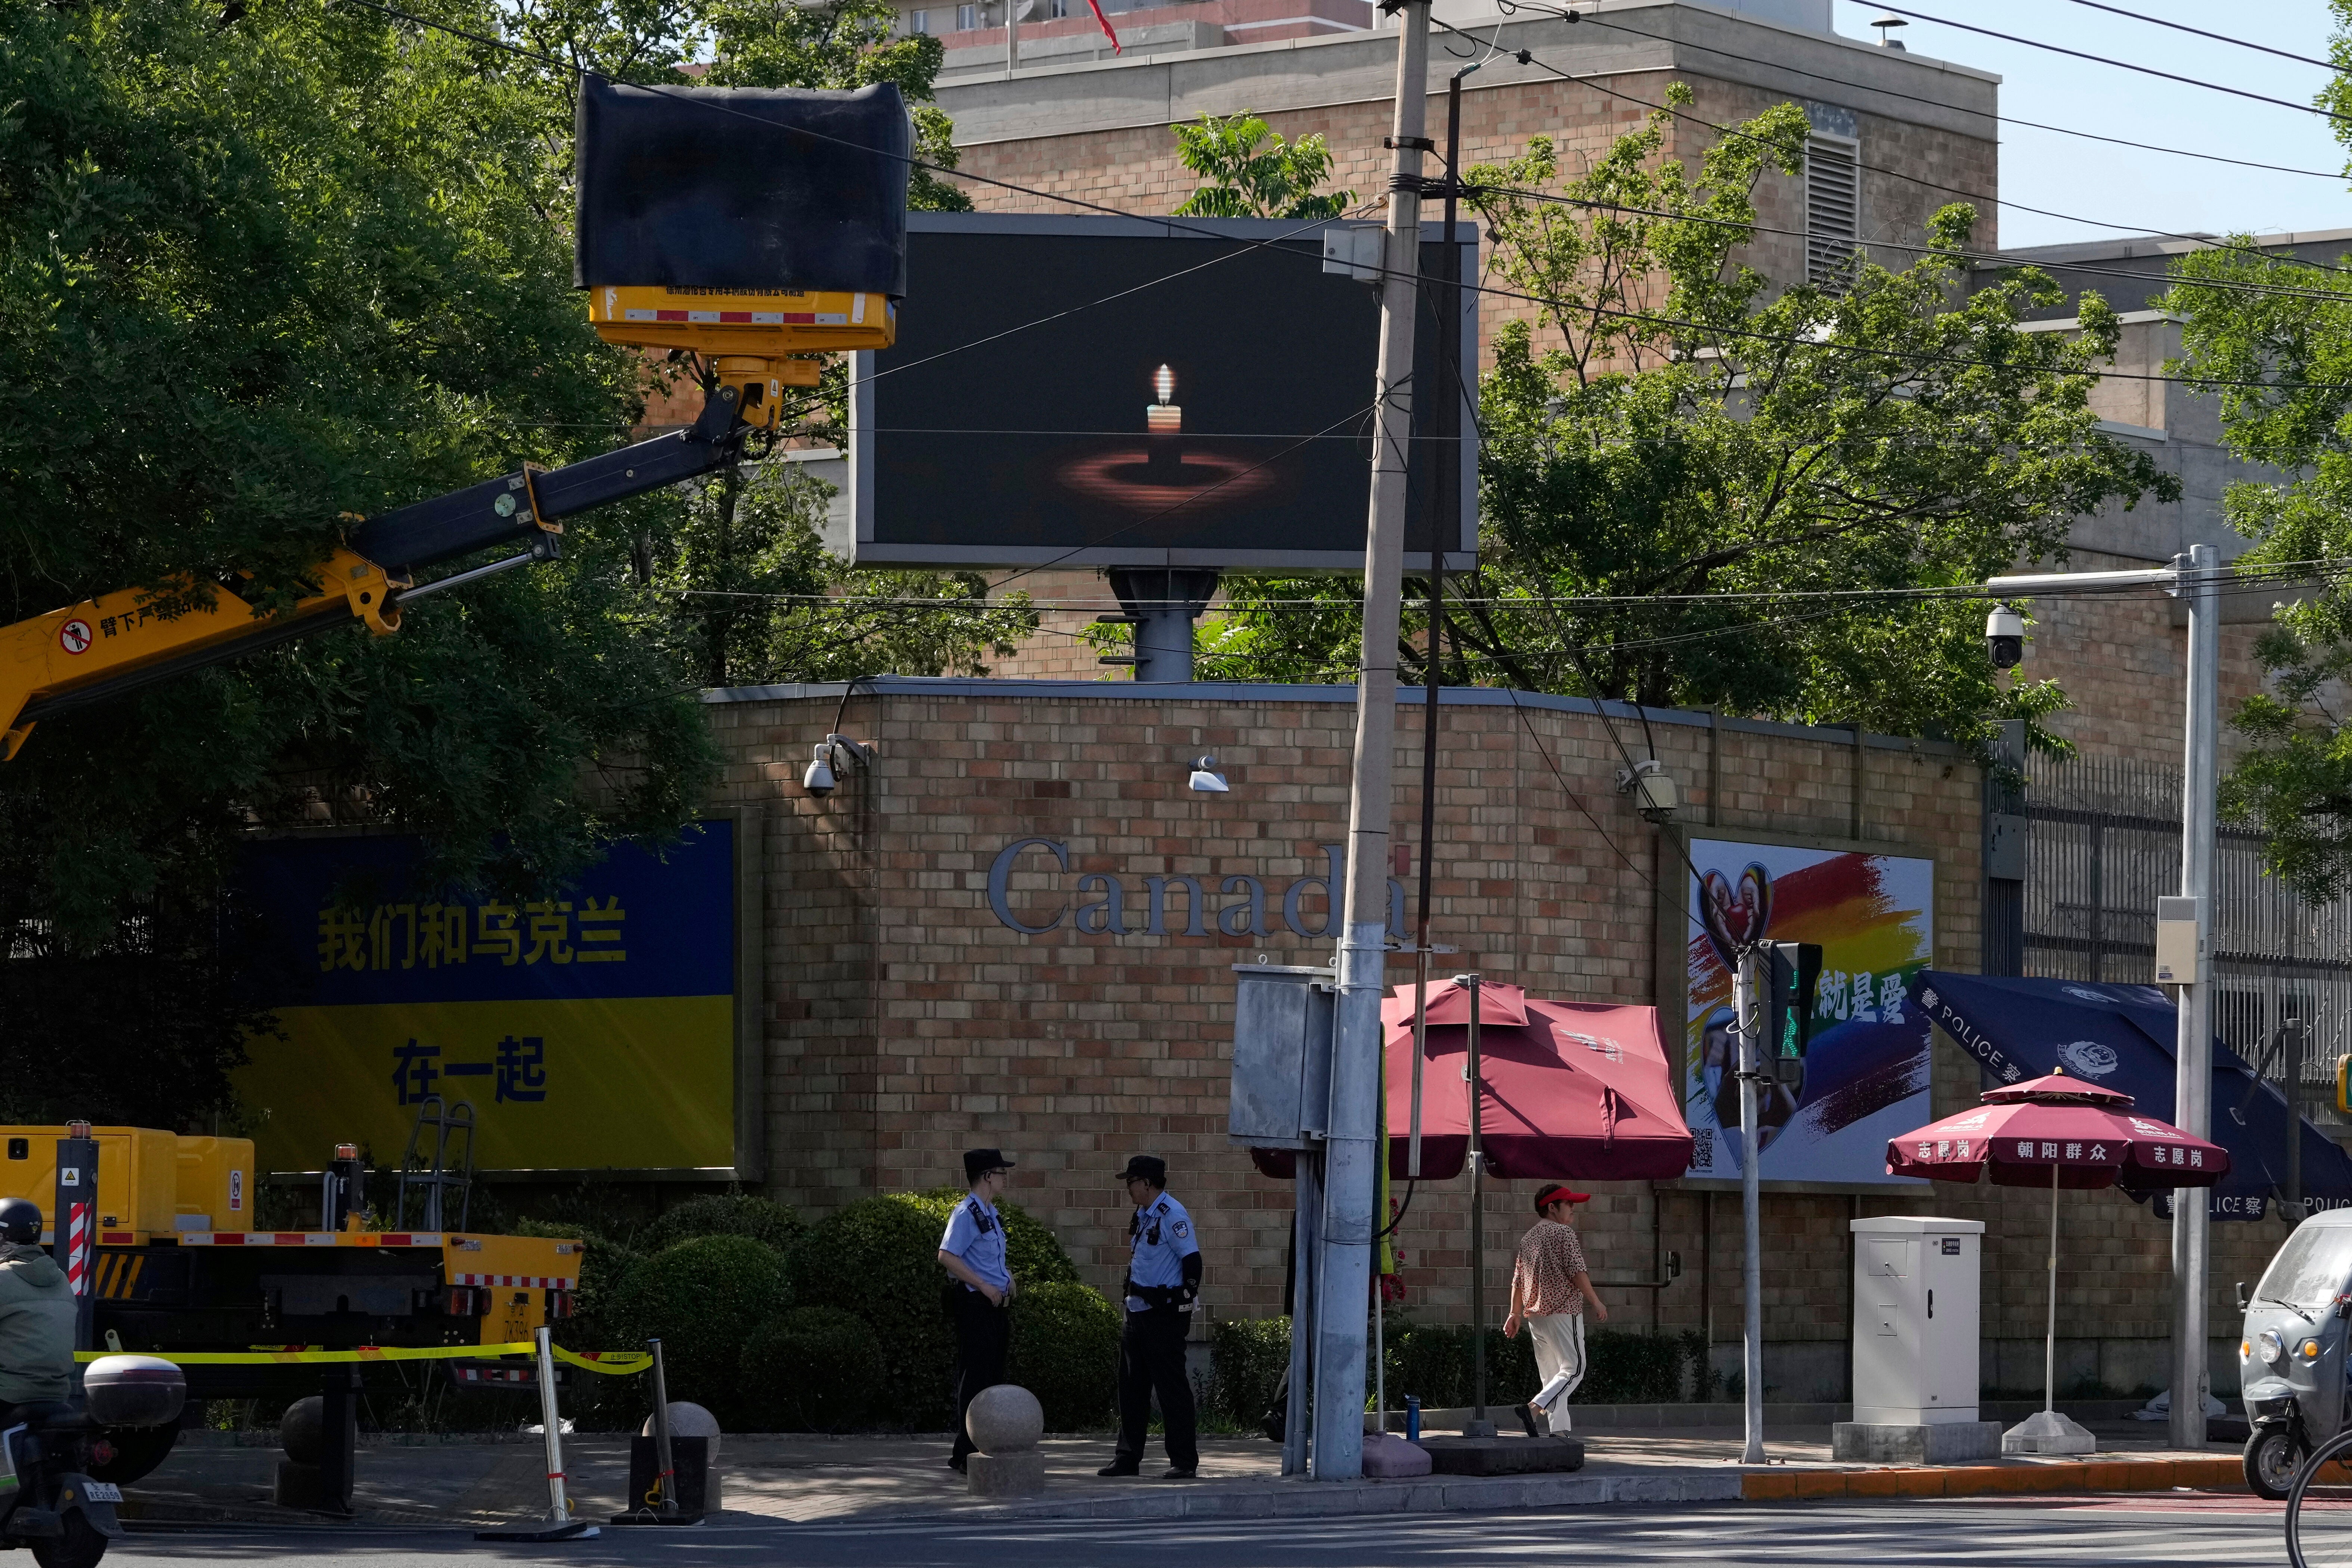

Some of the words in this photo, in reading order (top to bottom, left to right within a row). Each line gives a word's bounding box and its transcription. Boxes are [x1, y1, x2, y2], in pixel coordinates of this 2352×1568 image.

[317, 895, 626, 972] 我们和乌克兰
[1811, 969, 1907, 1025] 就是爱
[1922, 988, 1939, 1009] 警
[1942, 1005, 2003, 1068] POLICE
[2002, 1063, 2021, 1083] 察
[392, 1035, 546, 1106] 在一起
[1918, 1140, 1969, 1158] 志愿岗
[2017, 1141, 2107, 1160] 朝阳群众
[2154, 1146, 2202, 1167] 志愿岗
[2245, 1196, 2261, 1214] 察
[504, 1320, 529, 1343] ZK396
